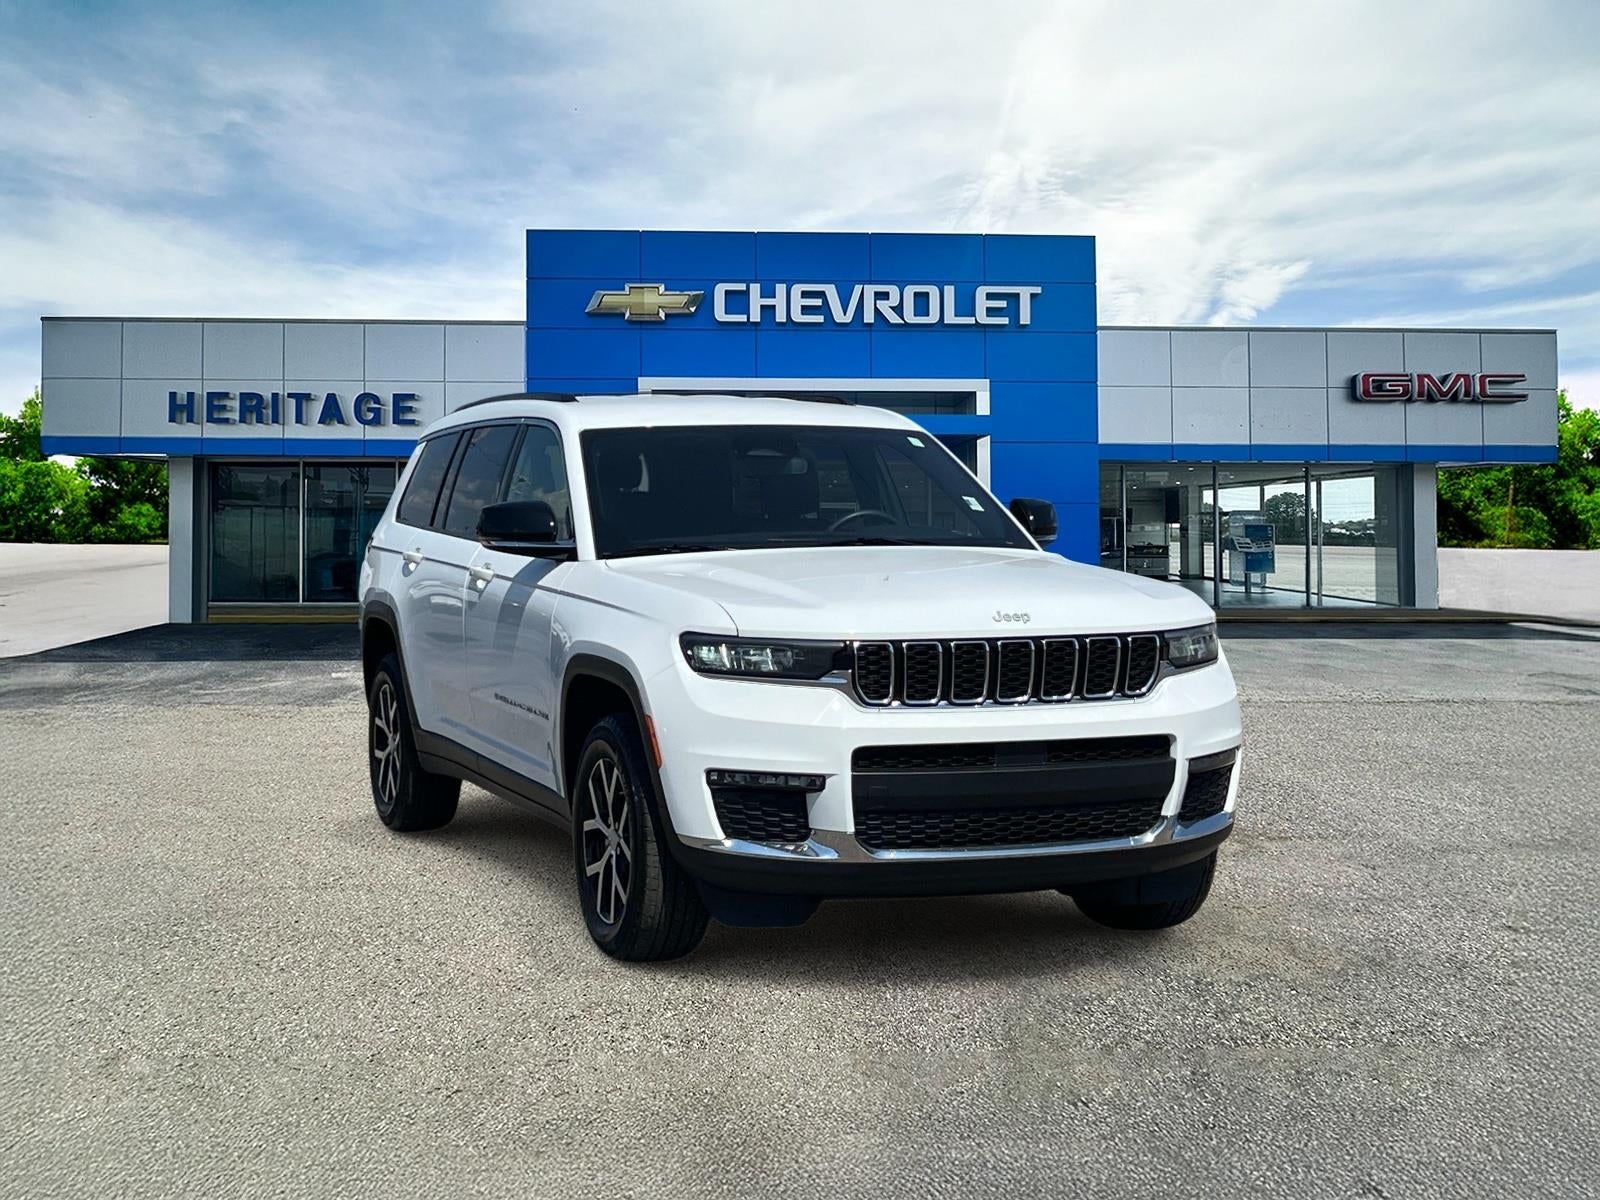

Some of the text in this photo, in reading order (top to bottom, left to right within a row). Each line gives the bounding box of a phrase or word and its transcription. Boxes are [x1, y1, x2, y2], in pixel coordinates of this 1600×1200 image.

[714, 283, 1042, 327] CHEVROLET
[1352, 371, 1528, 404] GMC
[168, 391, 420, 426] HERITAGE
[992, 610, 1031, 624] Jeep
